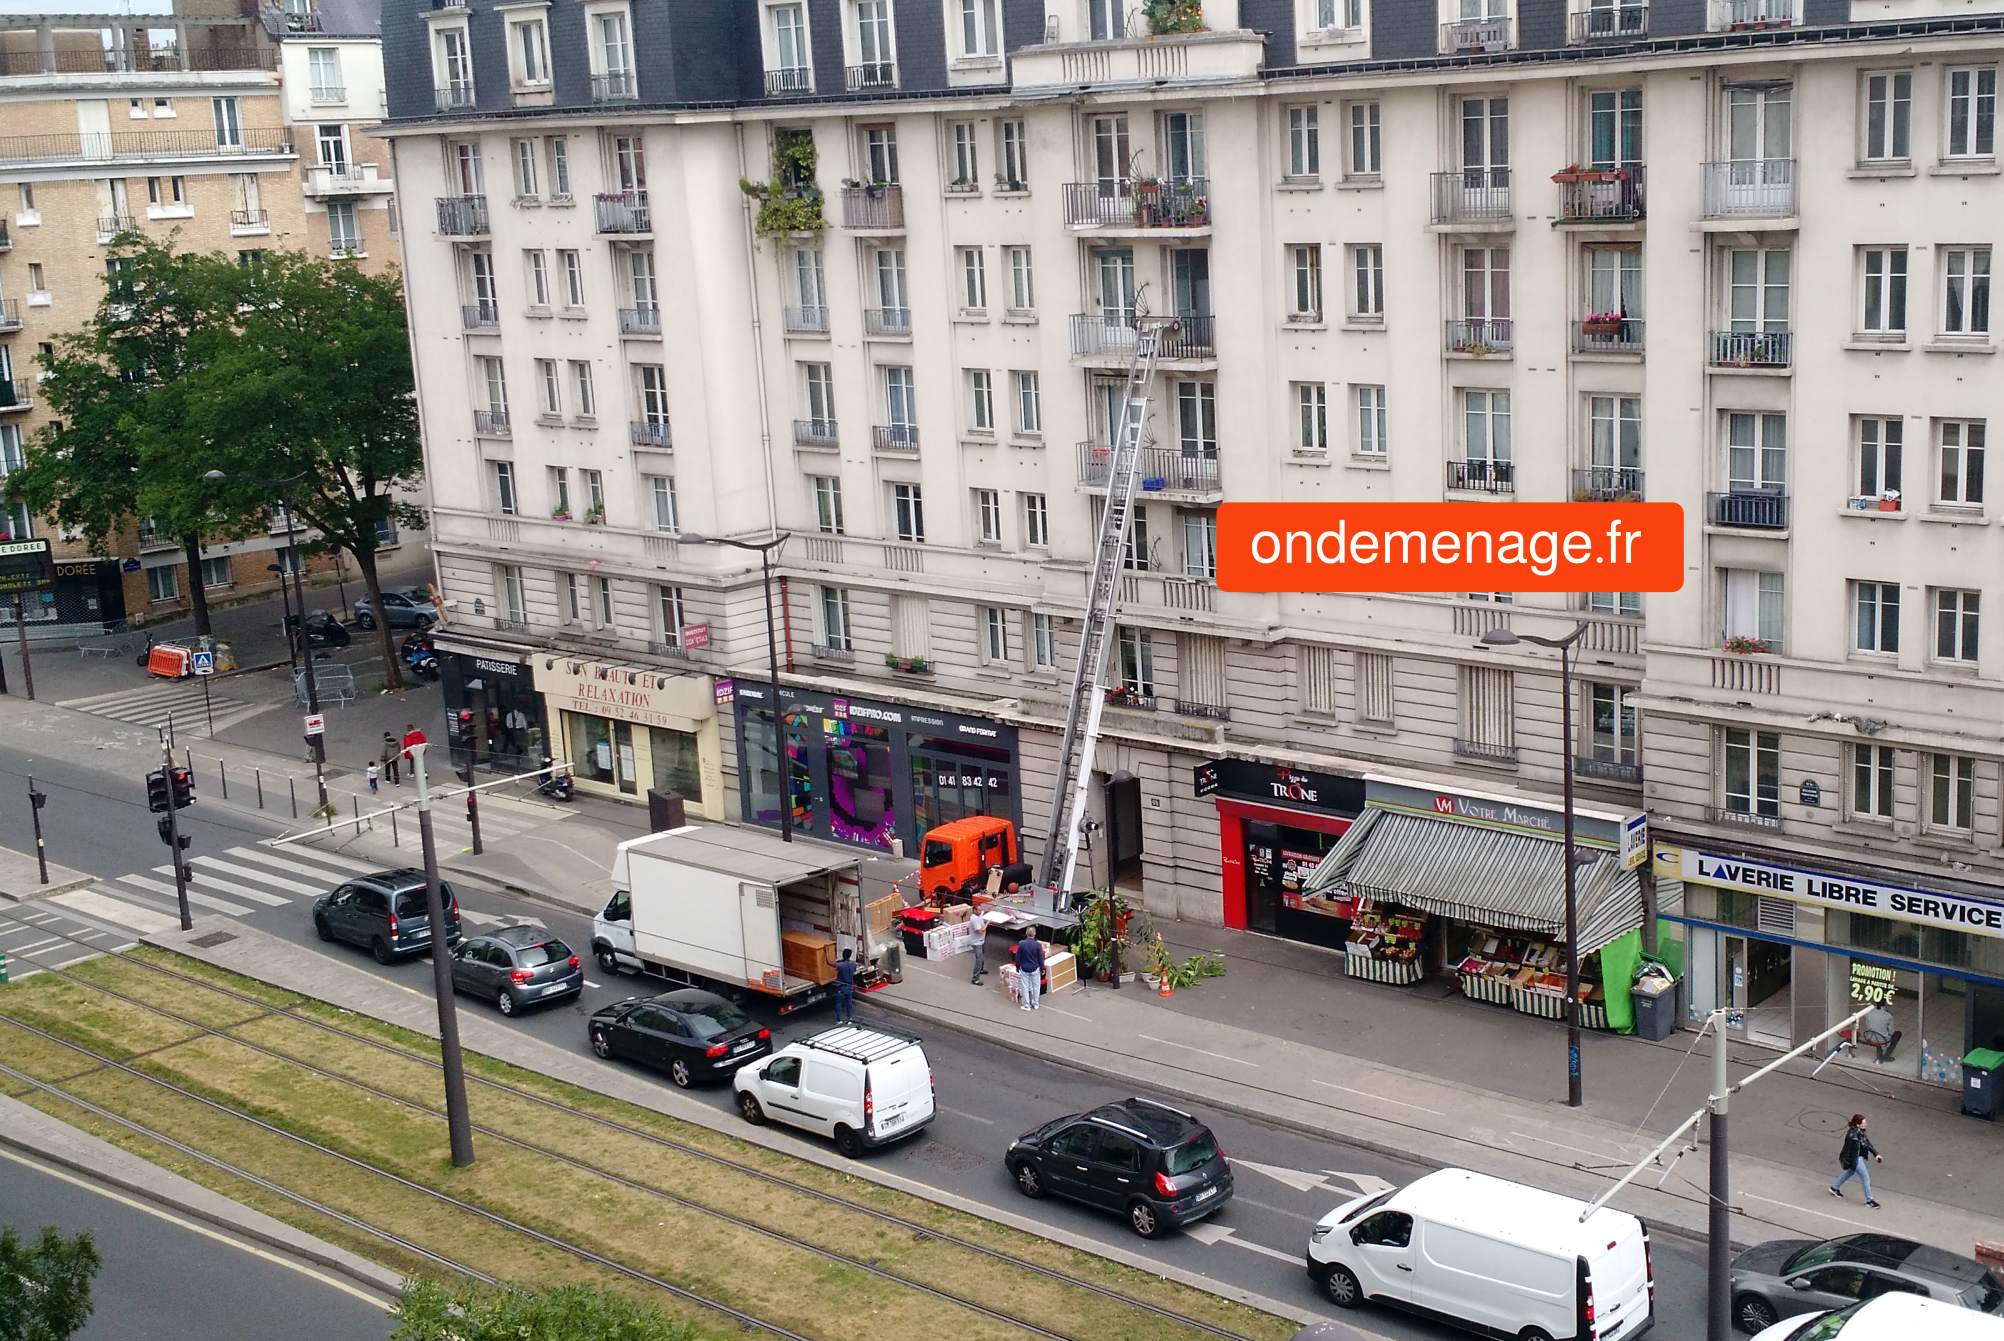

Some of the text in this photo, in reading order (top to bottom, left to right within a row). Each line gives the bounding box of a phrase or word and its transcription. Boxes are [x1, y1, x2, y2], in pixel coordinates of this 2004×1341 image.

[56, 563, 97, 577] DORÉE
[476, 659, 518, 676] PATISSERIE
[566, 660, 588, 678] SN
[642, 673, 657, 689] ET
[578, 682, 651, 708] RELAXATION
[572, 700, 591, 712] TEL
[601, 706, 612, 716] 09
[615, 708, 625, 718] 52
[629, 710, 640, 721] 46
[643, 712, 653, 724] 31
[656, 716, 668, 726] 59
[849, 705, 902, 723] IDZIFPRO.COM
[938, 774, 998, 788] 01 41 83 42 42
[1697, 859, 2003, 929] LAVERIE LIBRE SERVICE
[1852, 962, 1892, 982] PROMOTION
